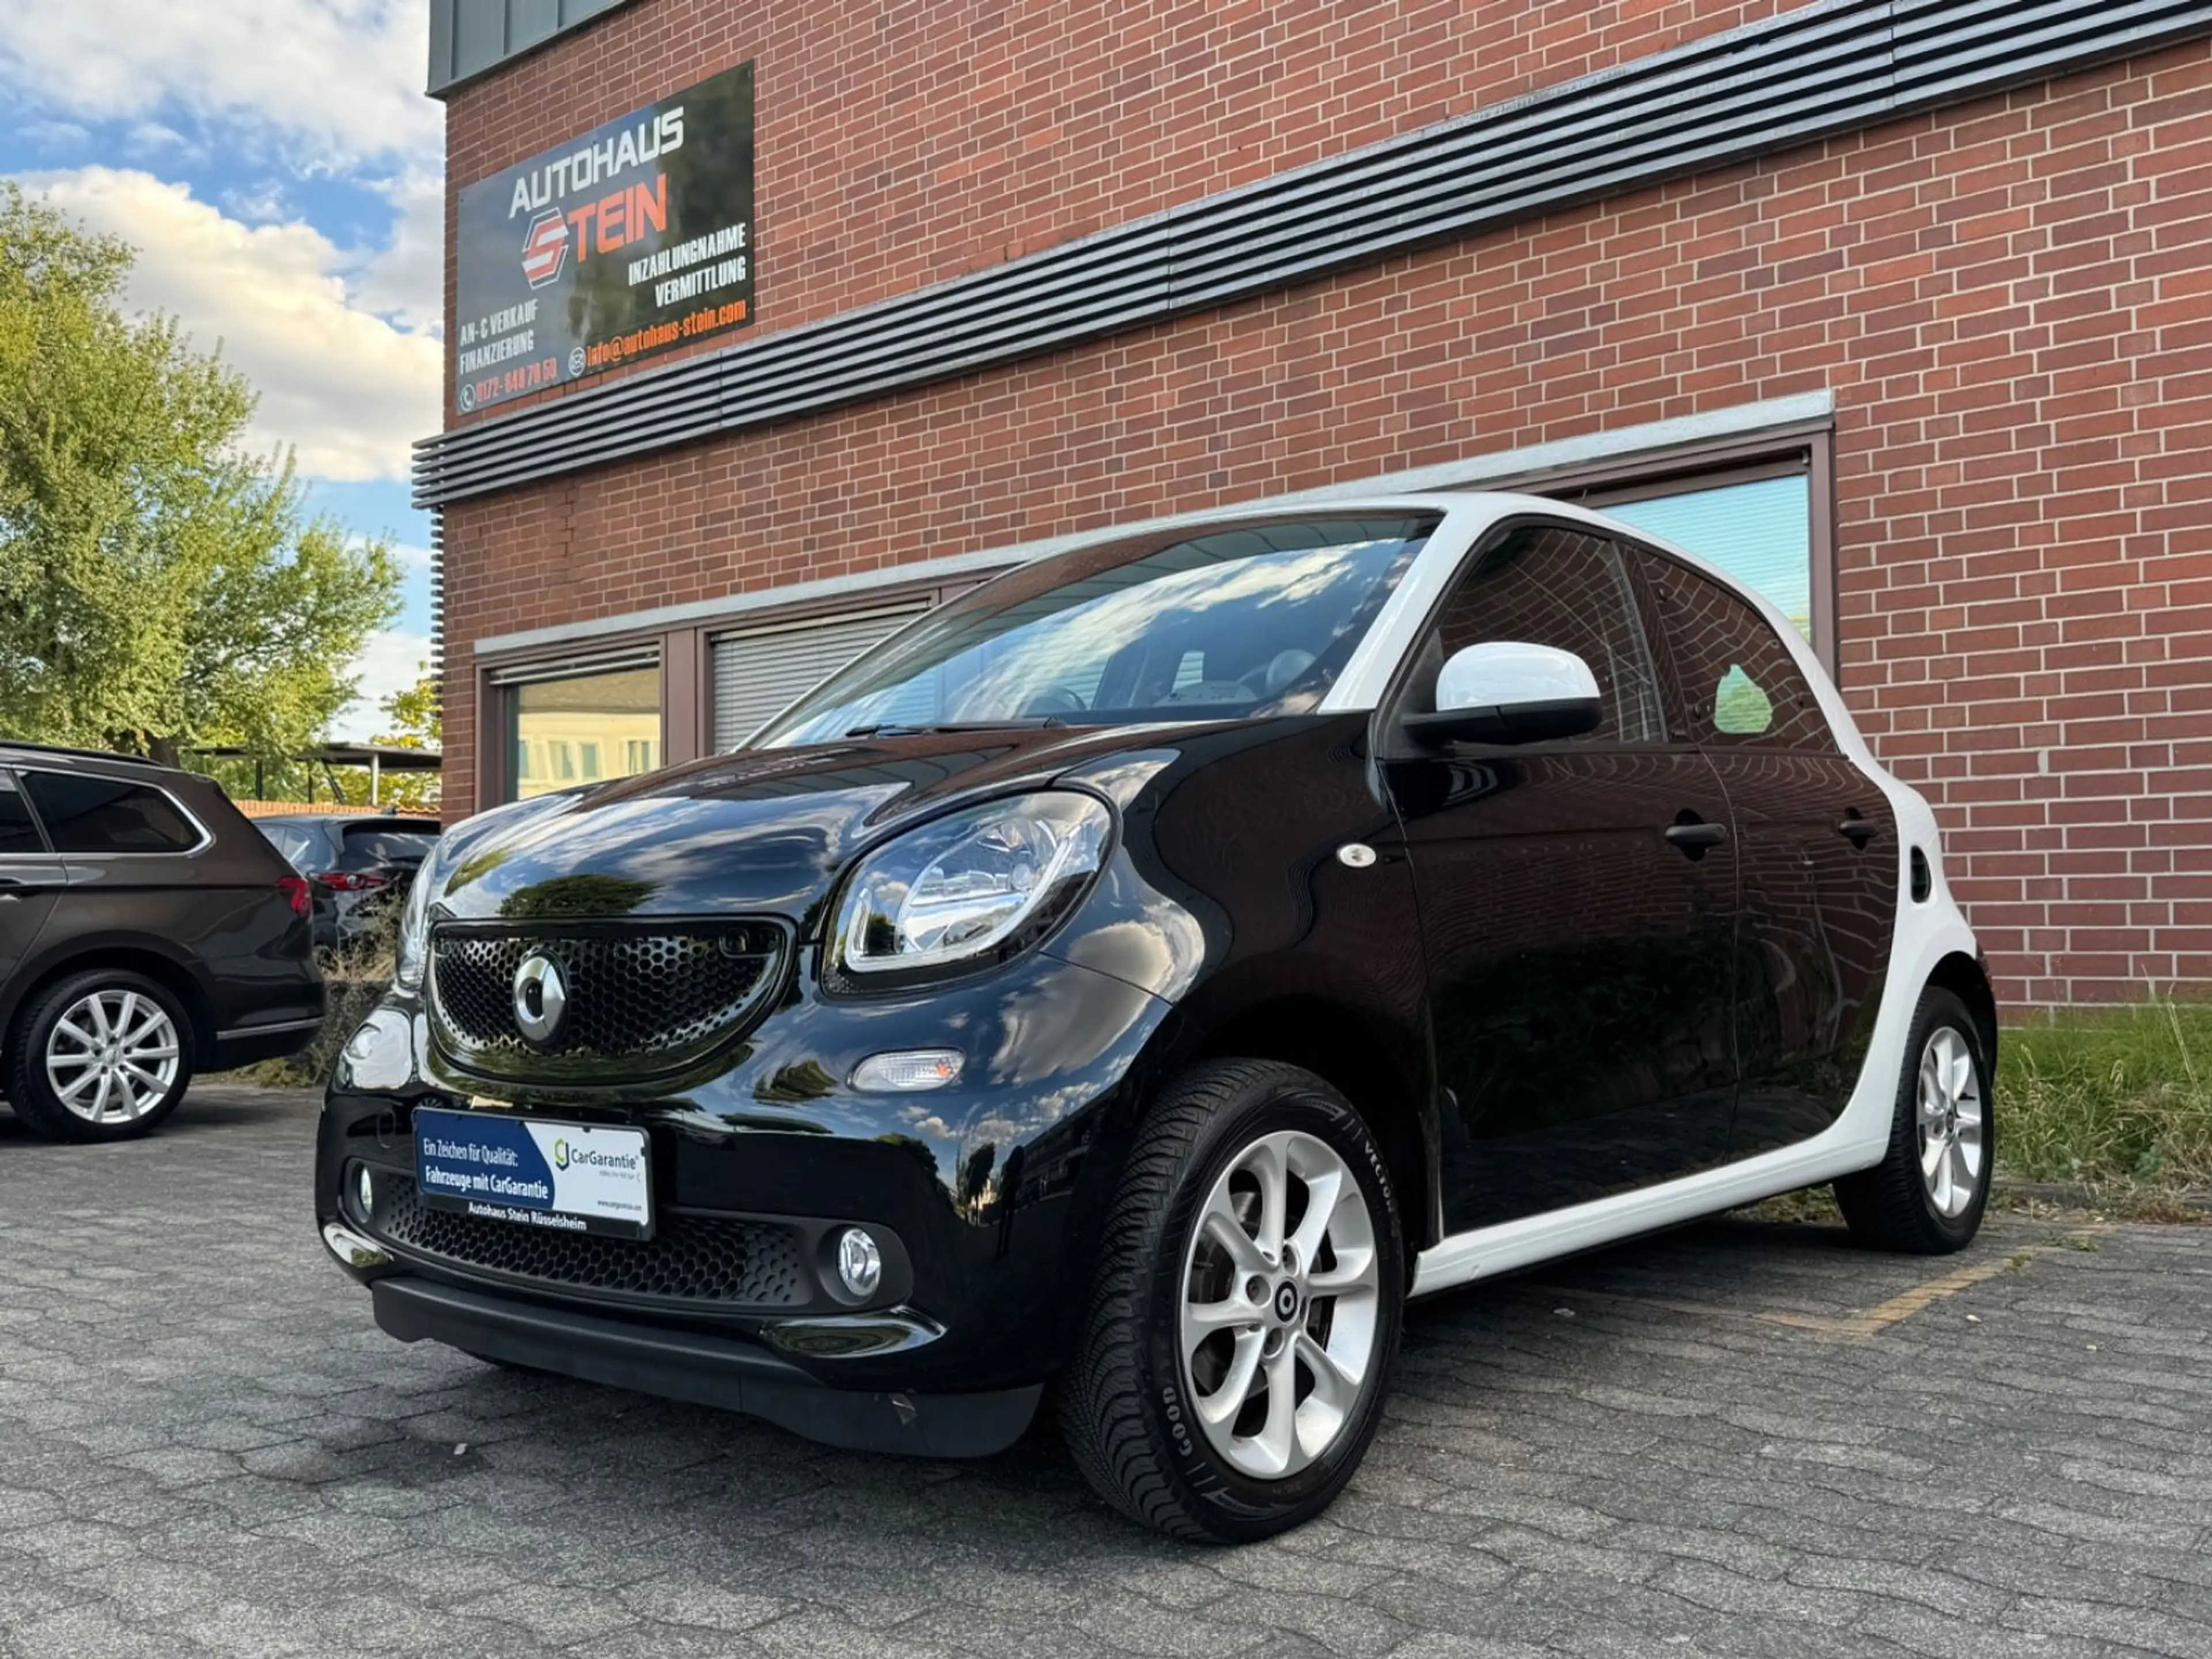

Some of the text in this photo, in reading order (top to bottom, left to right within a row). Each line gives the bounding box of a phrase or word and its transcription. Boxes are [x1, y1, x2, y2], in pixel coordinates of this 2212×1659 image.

[509, 106, 684, 219] AUTOHAUS
[522, 172, 667, 290] STEIN
[628, 222, 747, 287] INZAHLUNGNAHME
[654, 255, 747, 308] VERMITTLUNG
[490, 298, 539, 335] VERKAUF
[586, 299, 747, 367] info@autohaus-stein.com
[460, 328, 535, 374] FINANZIERUNG
[423, 1137, 518, 1167] Ein Zeichen für Qualität:
[571, 1148, 636, 1170] CarGarantie
[425, 1165, 549, 1200] Fahrzeuge mit CarGarantie
[468, 1201, 587, 1230] Autohaus Stein Rüsselsheim
